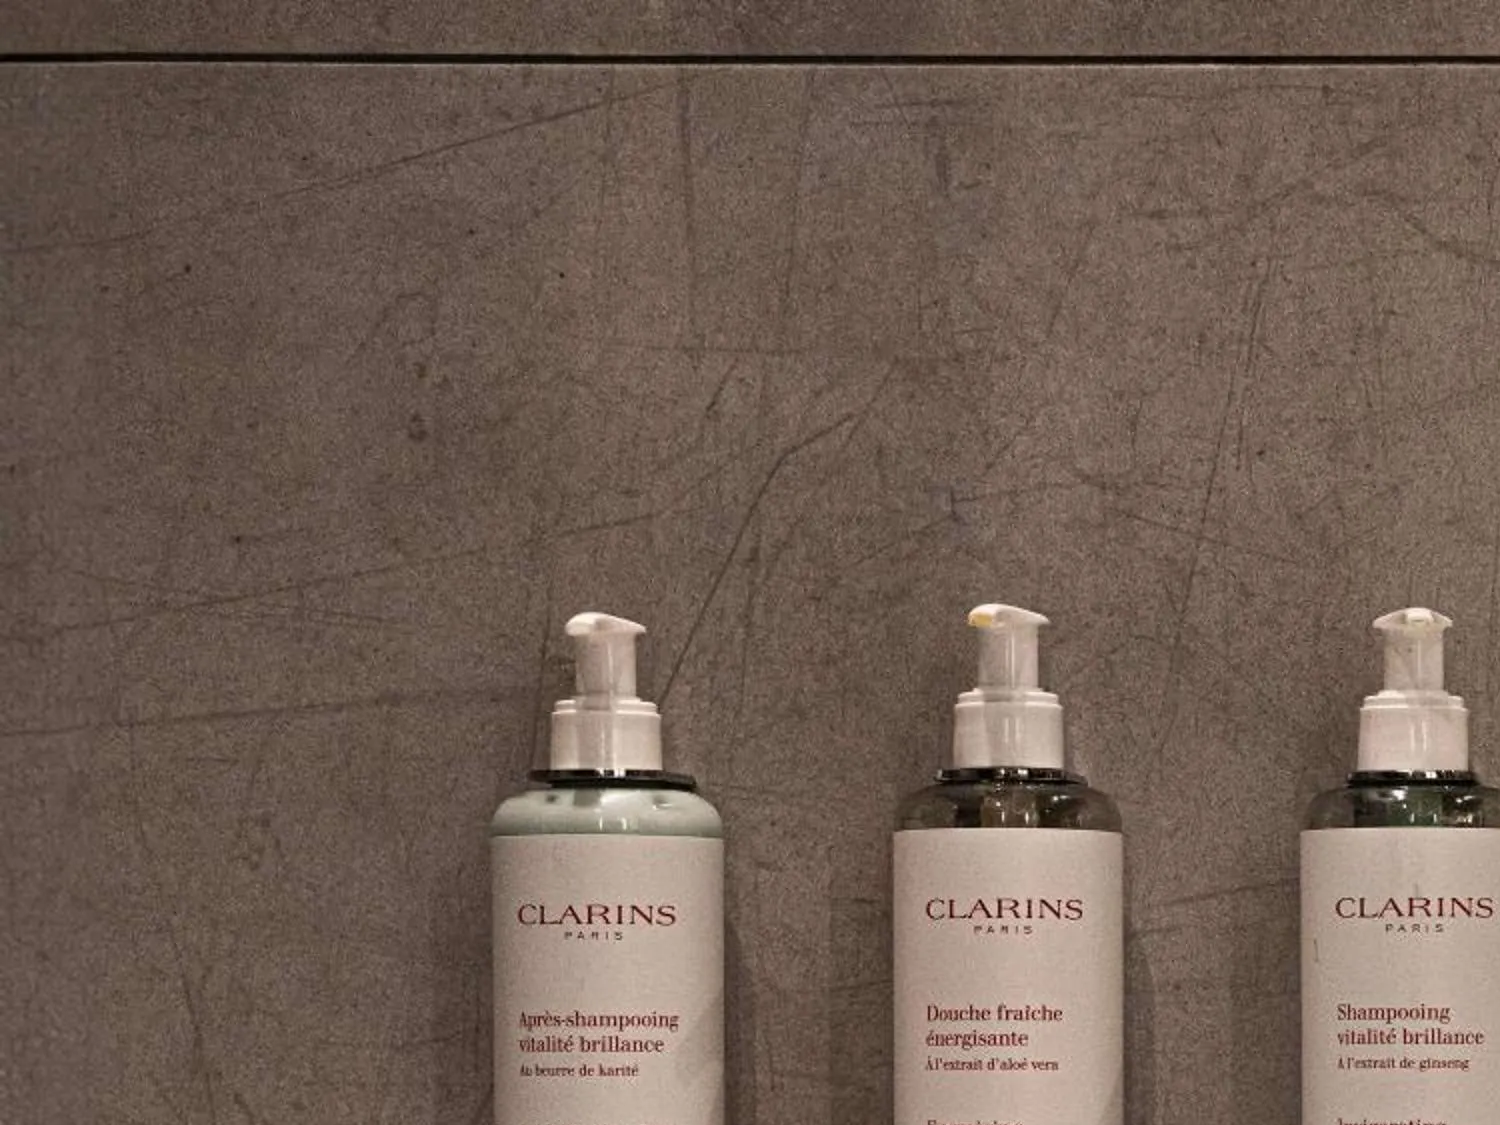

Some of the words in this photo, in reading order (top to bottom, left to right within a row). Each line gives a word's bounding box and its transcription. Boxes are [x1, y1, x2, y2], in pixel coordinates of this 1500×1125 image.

[517, 903, 677, 927] CLARINS
[925, 898, 1084, 921] CLARINS
[1335, 896, 1494, 919] CLARINS
[564, 930, 624, 941] PARIS
[973, 925, 1033, 935] PARIS
[1385, 923, 1444, 933] PARIS
[518, 1010, 680, 1032] Après-shampooing
[926, 1003, 992, 1022] Douche
[1337, 1003, 1451, 1024] Shampooing
[518, 1035, 574, 1053] vitalité
[579, 1036, 665, 1053] brillance
[925, 1029, 1029, 1050] énergisante
[1337, 1027, 1397, 1045] vitalité
[1402, 1027, 1485, 1045] brillance
[535, 1064, 575, 1077] beurre
[579, 1063, 595, 1077] de
[597, 1063, 639, 1077] karité
[1031, 1059, 1059, 1071] vera
[1400, 1056, 1416, 1069] de
[1419, 1057, 1470, 1072] ginseng
